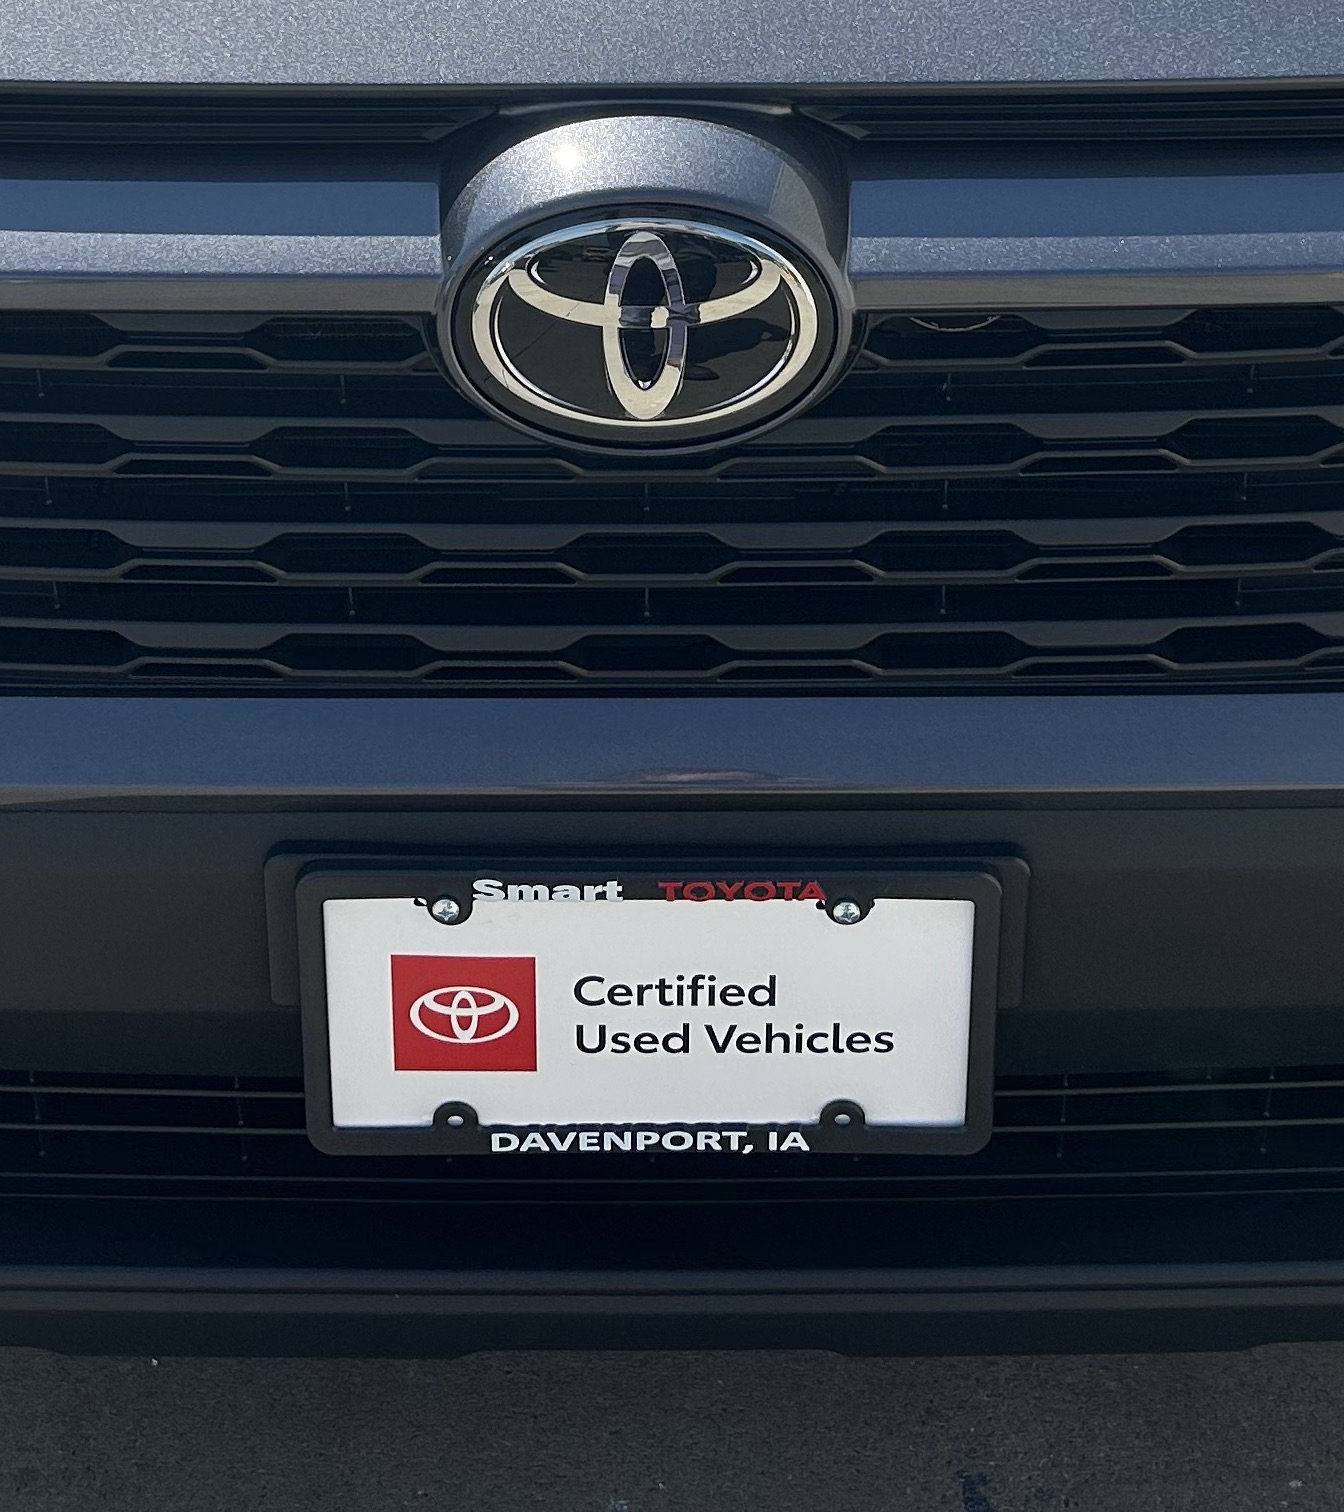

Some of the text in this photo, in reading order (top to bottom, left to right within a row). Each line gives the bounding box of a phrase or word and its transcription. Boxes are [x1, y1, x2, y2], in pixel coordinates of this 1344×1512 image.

[472, 879, 827, 902] Smart TOYOTA
[573, 974, 776, 1006] Certified
[576, 1023, 895, 1053] Used Vehicles
[491, 1132, 810, 1154] DAVENPORT, IA
